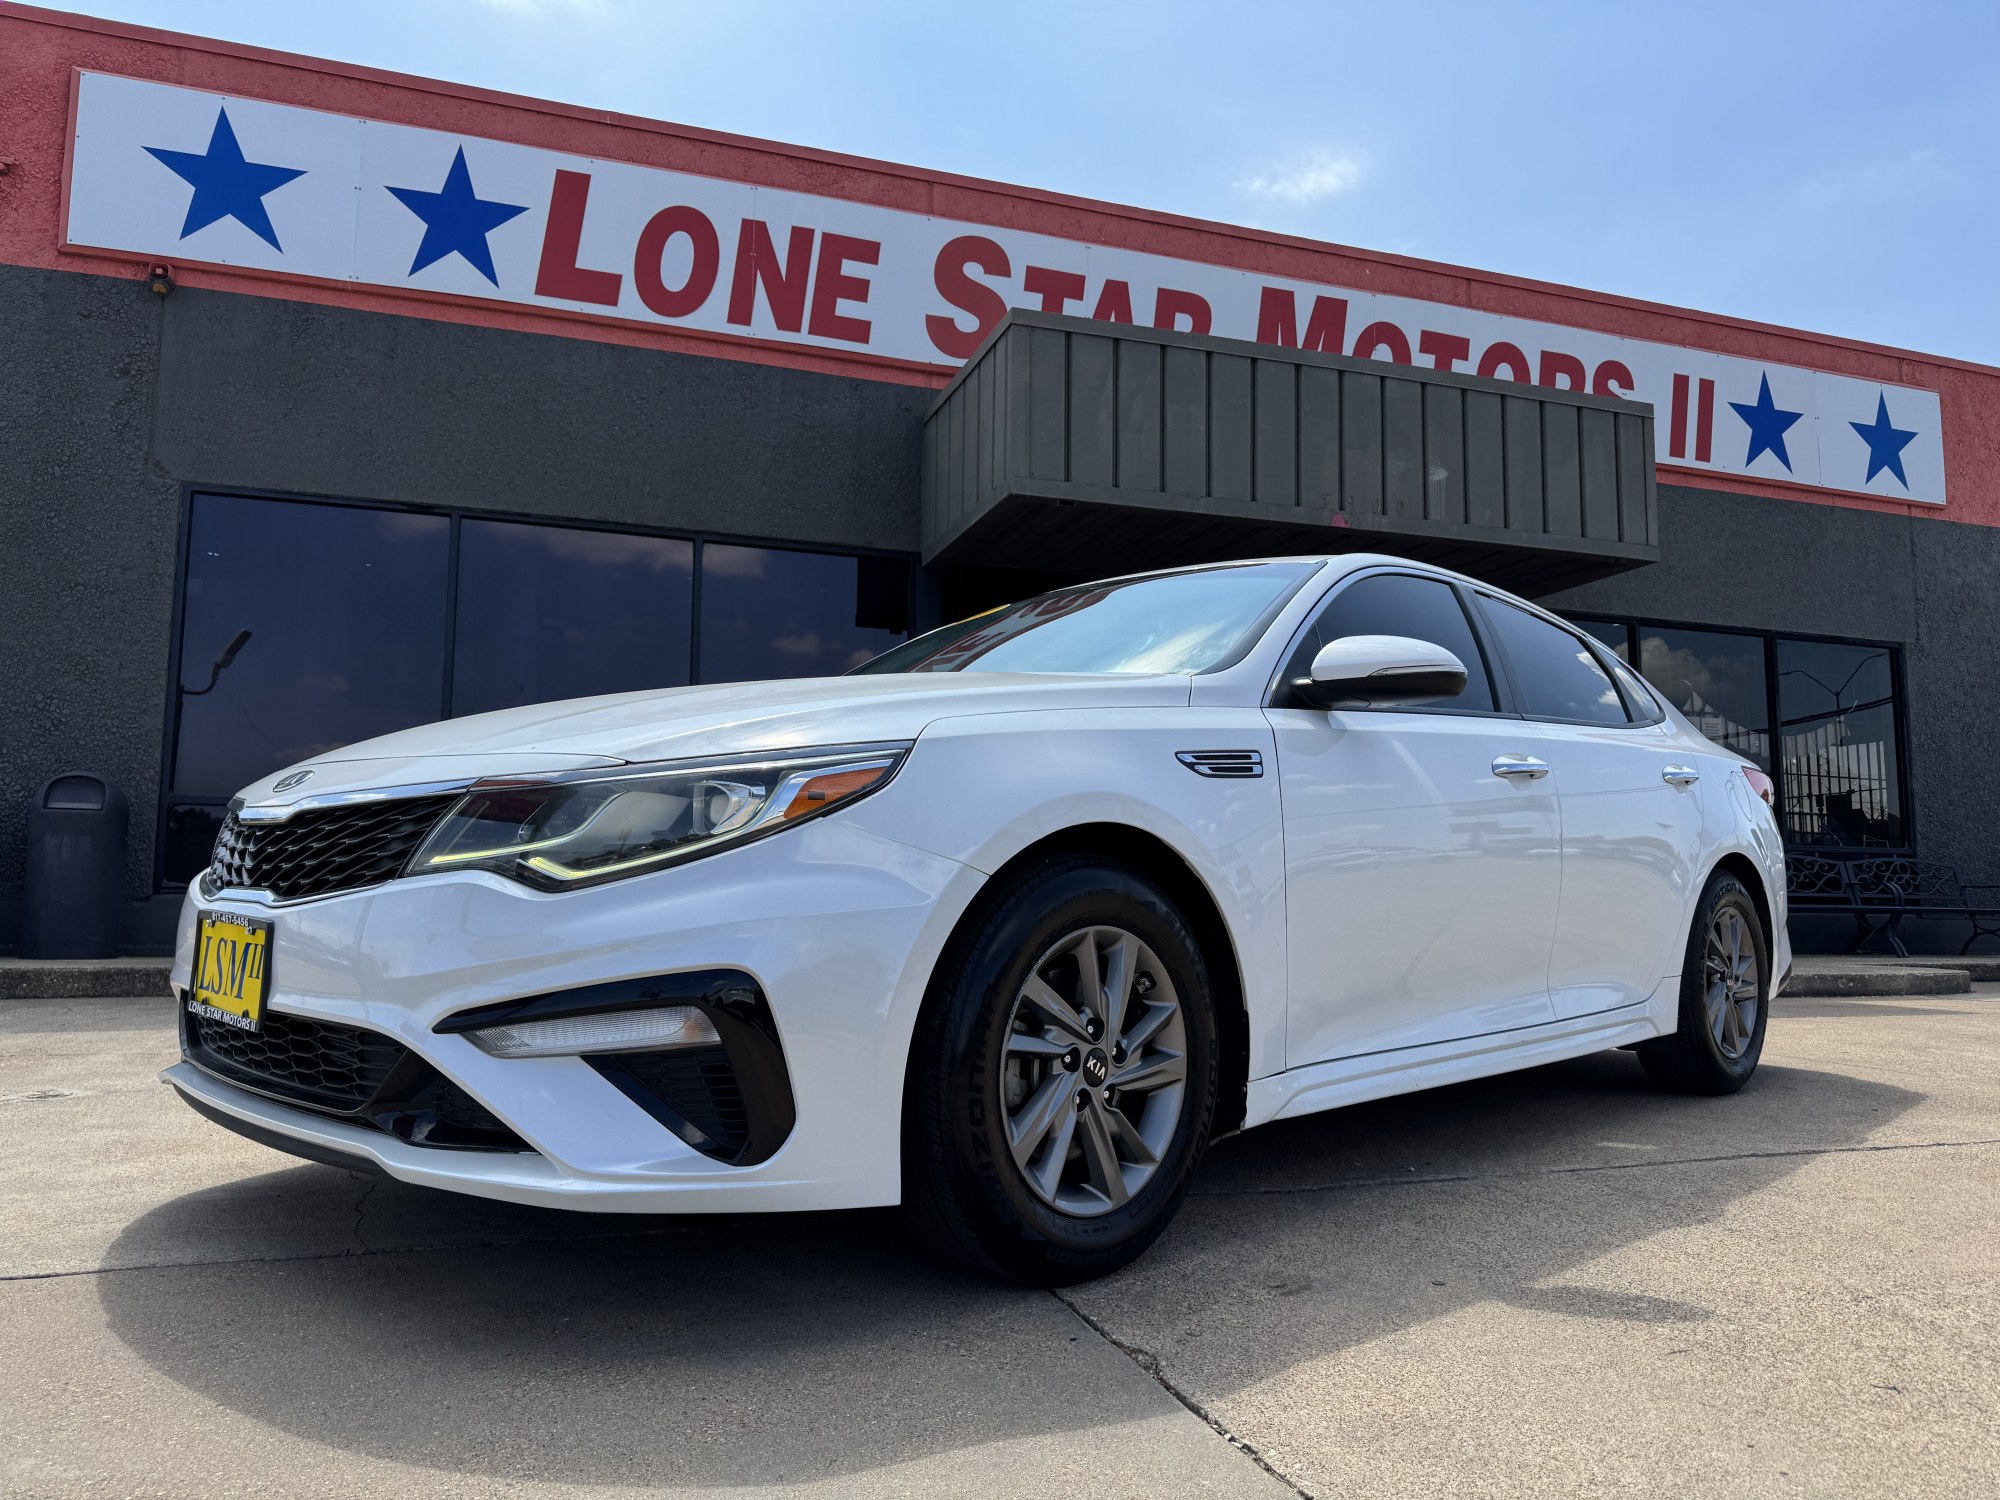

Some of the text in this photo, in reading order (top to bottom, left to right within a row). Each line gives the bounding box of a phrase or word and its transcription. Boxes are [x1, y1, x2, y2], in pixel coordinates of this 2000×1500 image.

[534, 169, 882, 345] LONE
[1669, 373, 1715, 463] II
[199, 936, 252, 999] LSM
[189, 1000, 206, 1016] LONE
[207, 1007, 222, 1021] STAR
[222, 1012, 250, 1030] MOTORS
[1086, 1055, 1106, 1080] KIA
